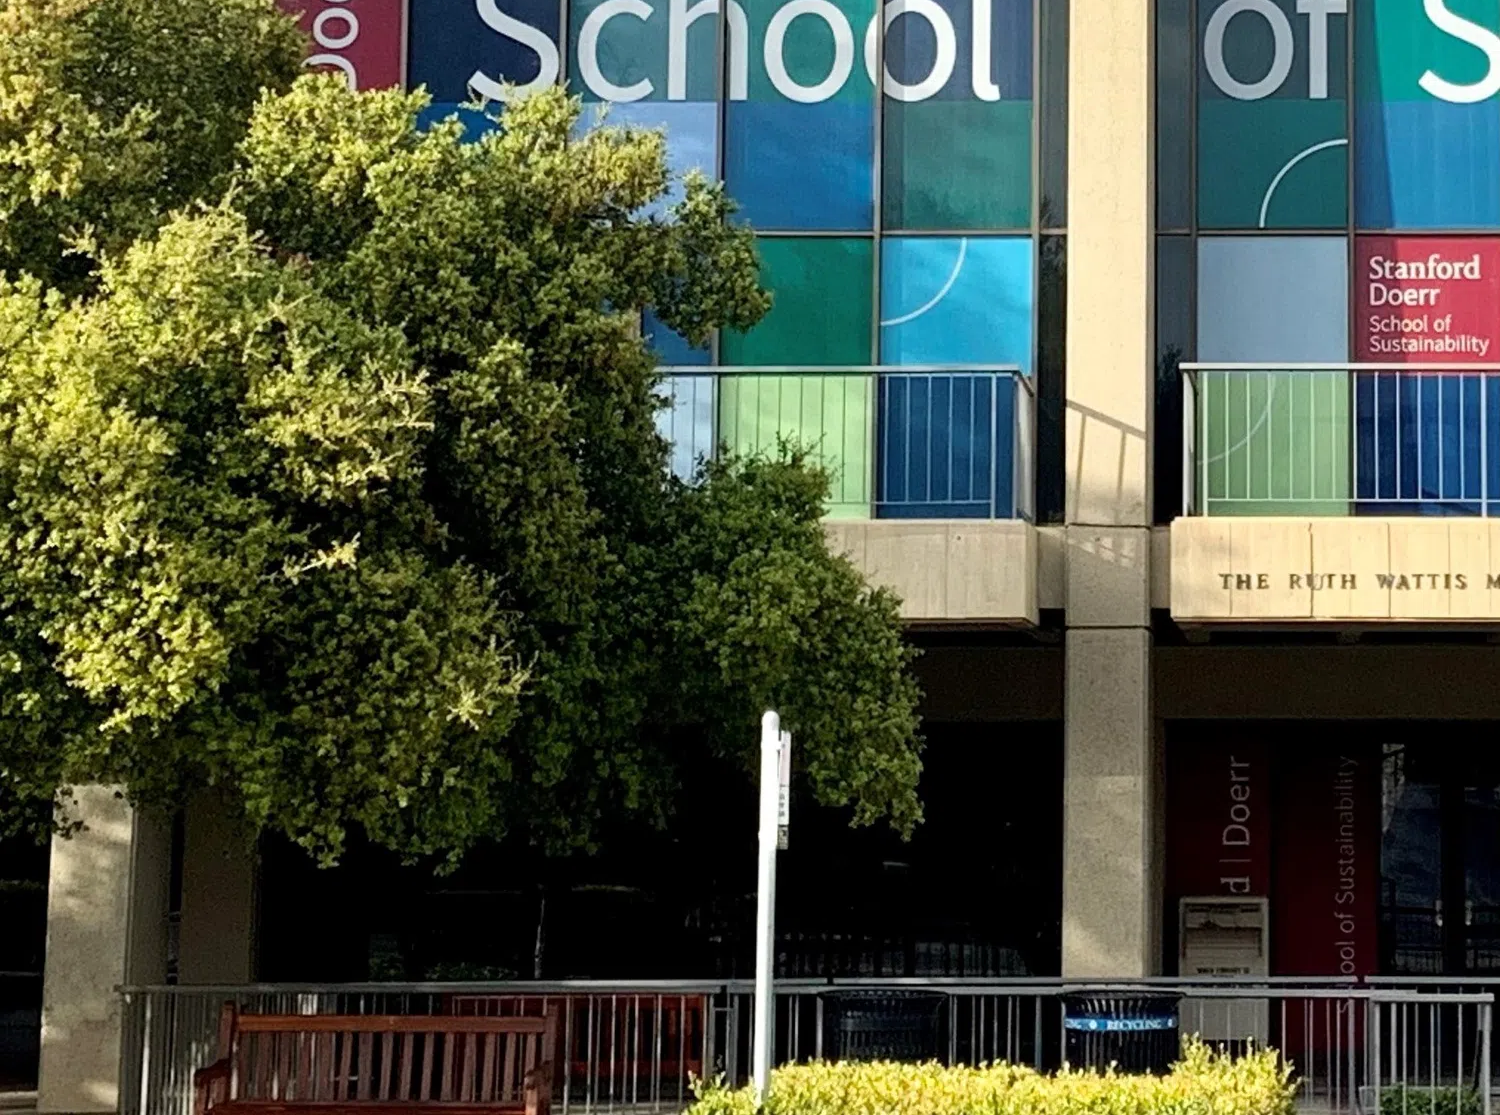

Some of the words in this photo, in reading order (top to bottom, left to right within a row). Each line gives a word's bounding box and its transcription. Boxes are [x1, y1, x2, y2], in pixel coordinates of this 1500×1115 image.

[1369, 253, 1481, 279] Stanford
[1369, 282, 1440, 306] Doerr
[1369, 314, 1428, 332] School
[1432, 313, 1452, 332] of
[1369, 334, 1490, 356] Sustainability
[1218, 573, 1271, 590] THE
[1289, 573, 1358, 590] RUTH
[1375, 573, 1468, 590] WATTIS
[1222, 755, 1251, 846] Doerr
[1334, 755, 1358, 904] Sustainability
[1333, 912, 1356, 934] of
[1106, 1018, 1163, 1031] RECYCLING
